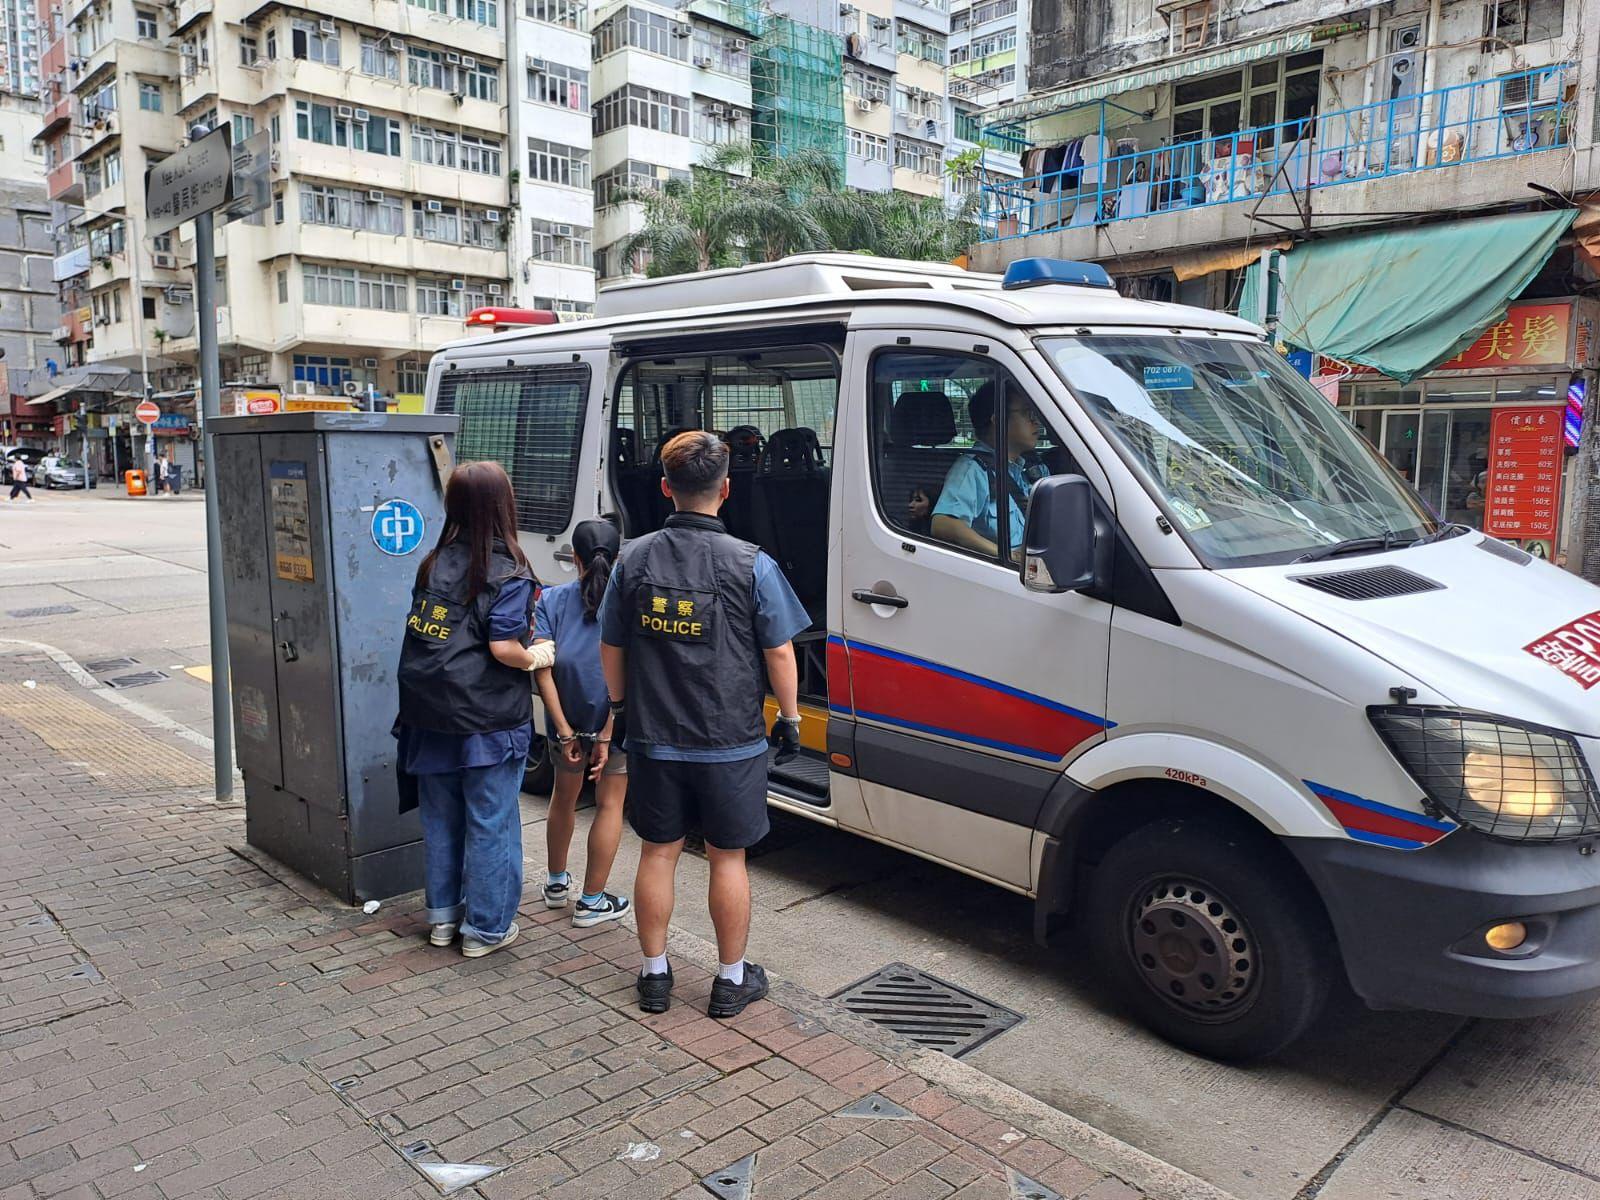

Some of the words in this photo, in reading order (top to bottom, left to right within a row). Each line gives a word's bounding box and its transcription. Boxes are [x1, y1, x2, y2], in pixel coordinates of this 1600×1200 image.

[1449, 313, 1560, 362] 美髮
[421, 599, 448, 621] 察
[652, 596, 694, 616] 警察
[641, 614, 702, 636] POLICE
[1164, 767, 1207, 787] 420kPa
